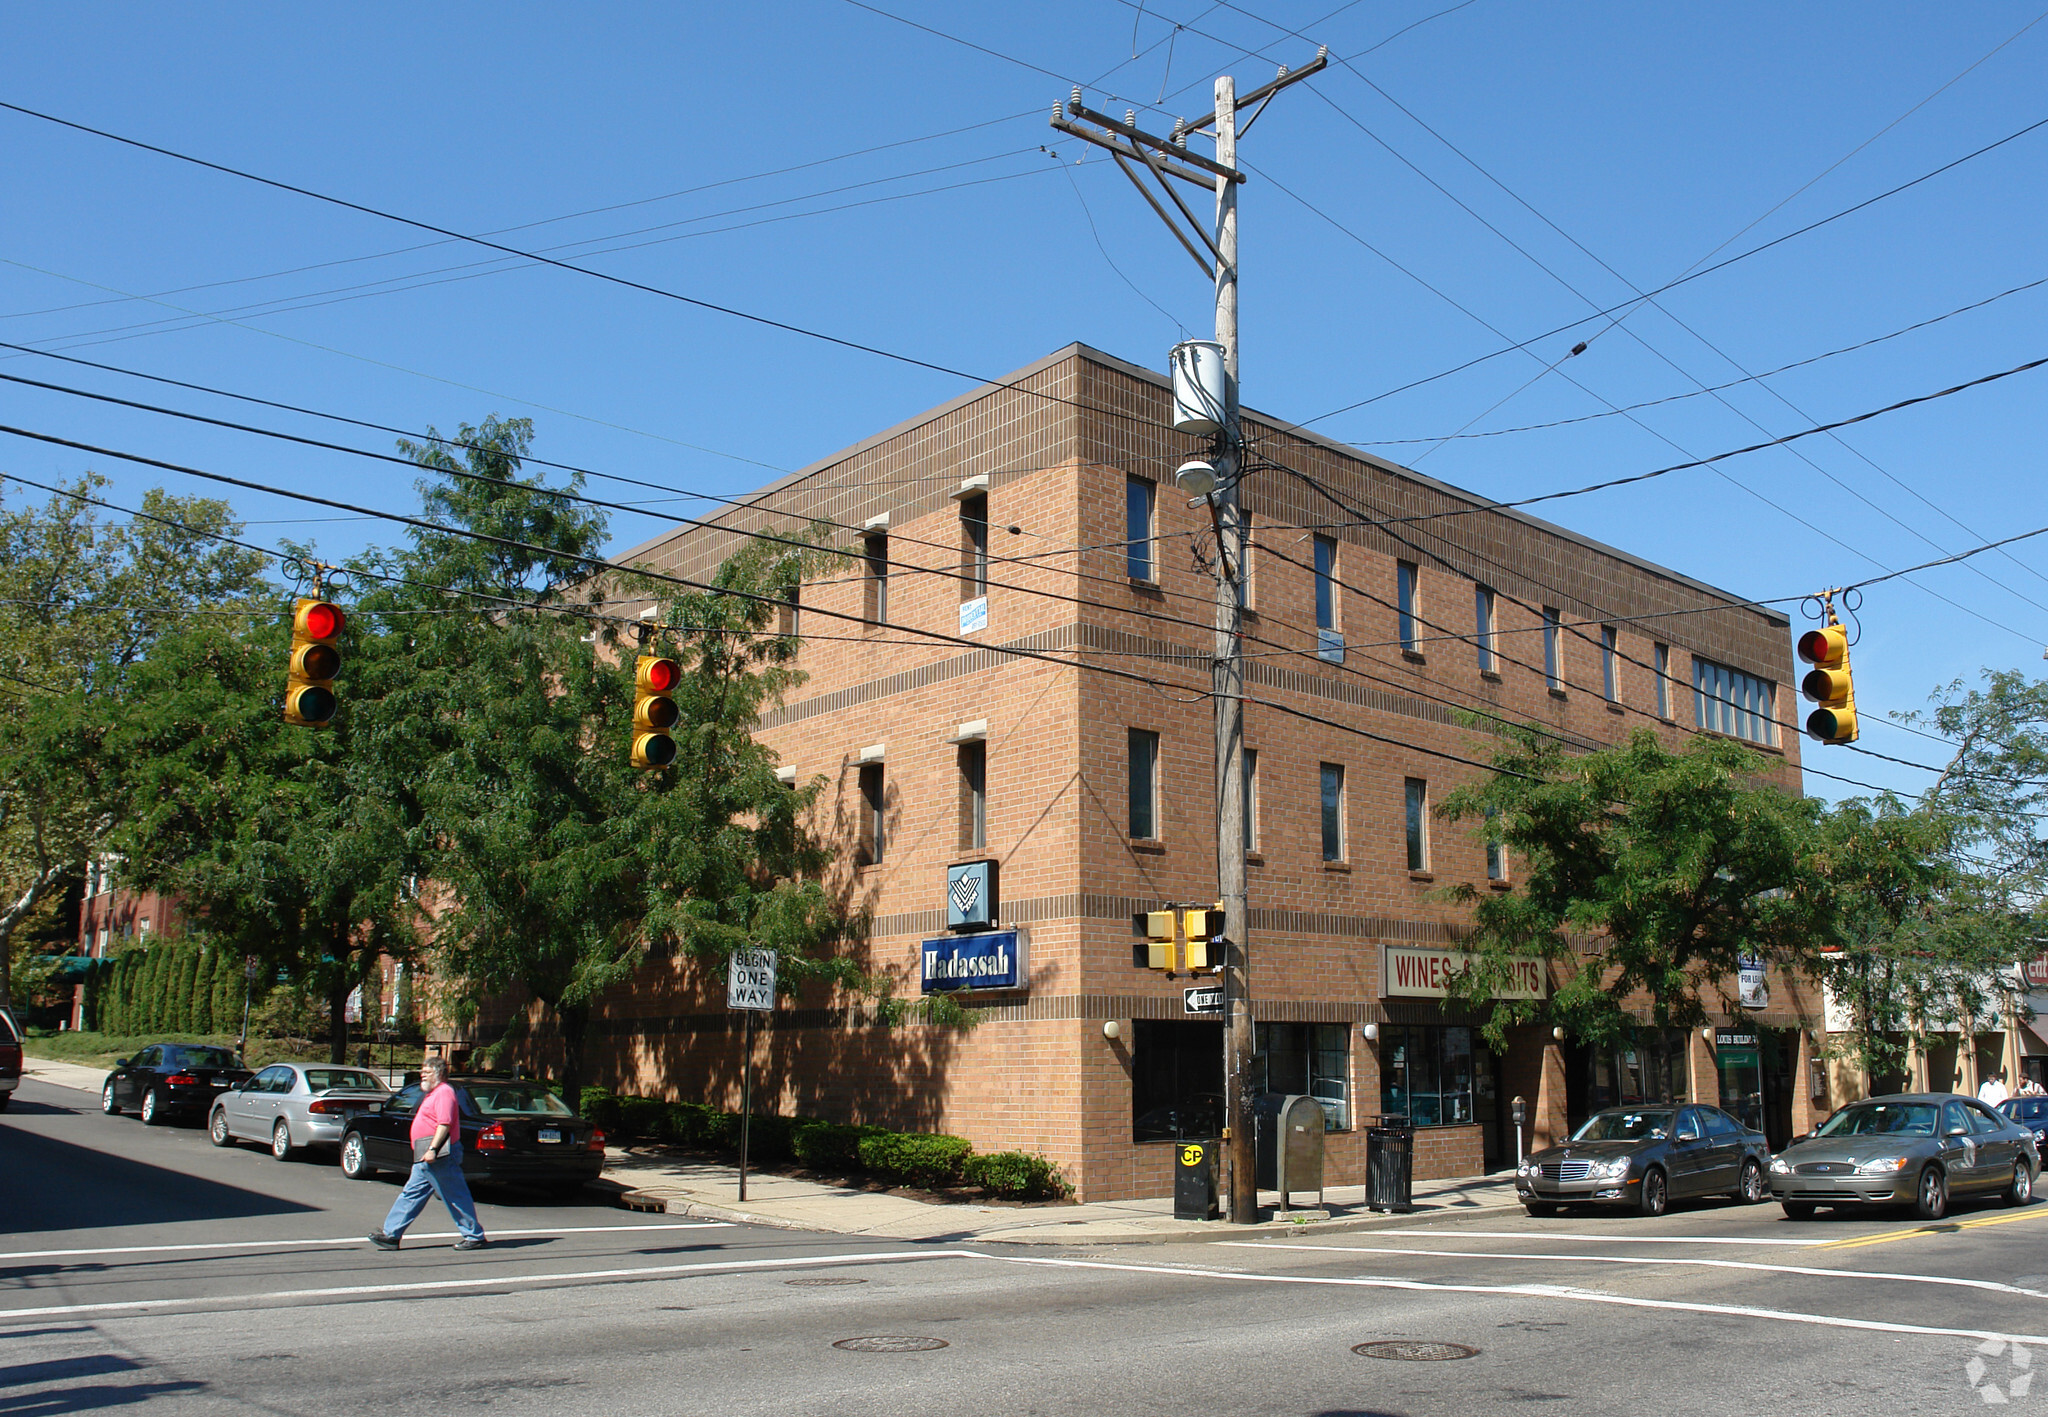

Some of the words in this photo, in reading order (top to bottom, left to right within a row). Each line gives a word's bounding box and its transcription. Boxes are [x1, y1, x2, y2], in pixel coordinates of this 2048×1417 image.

[736, 952, 771, 968] BEGIN
[924, 944, 1009, 980] Hadassah
[737, 970, 768, 986] ONE
[1395, 955, 1452, 990] WINES
[736, 988, 768, 1004] WAY
[1197, 994, 1208, 1004] ONE
[1183, 1149, 1202, 1162] CP
